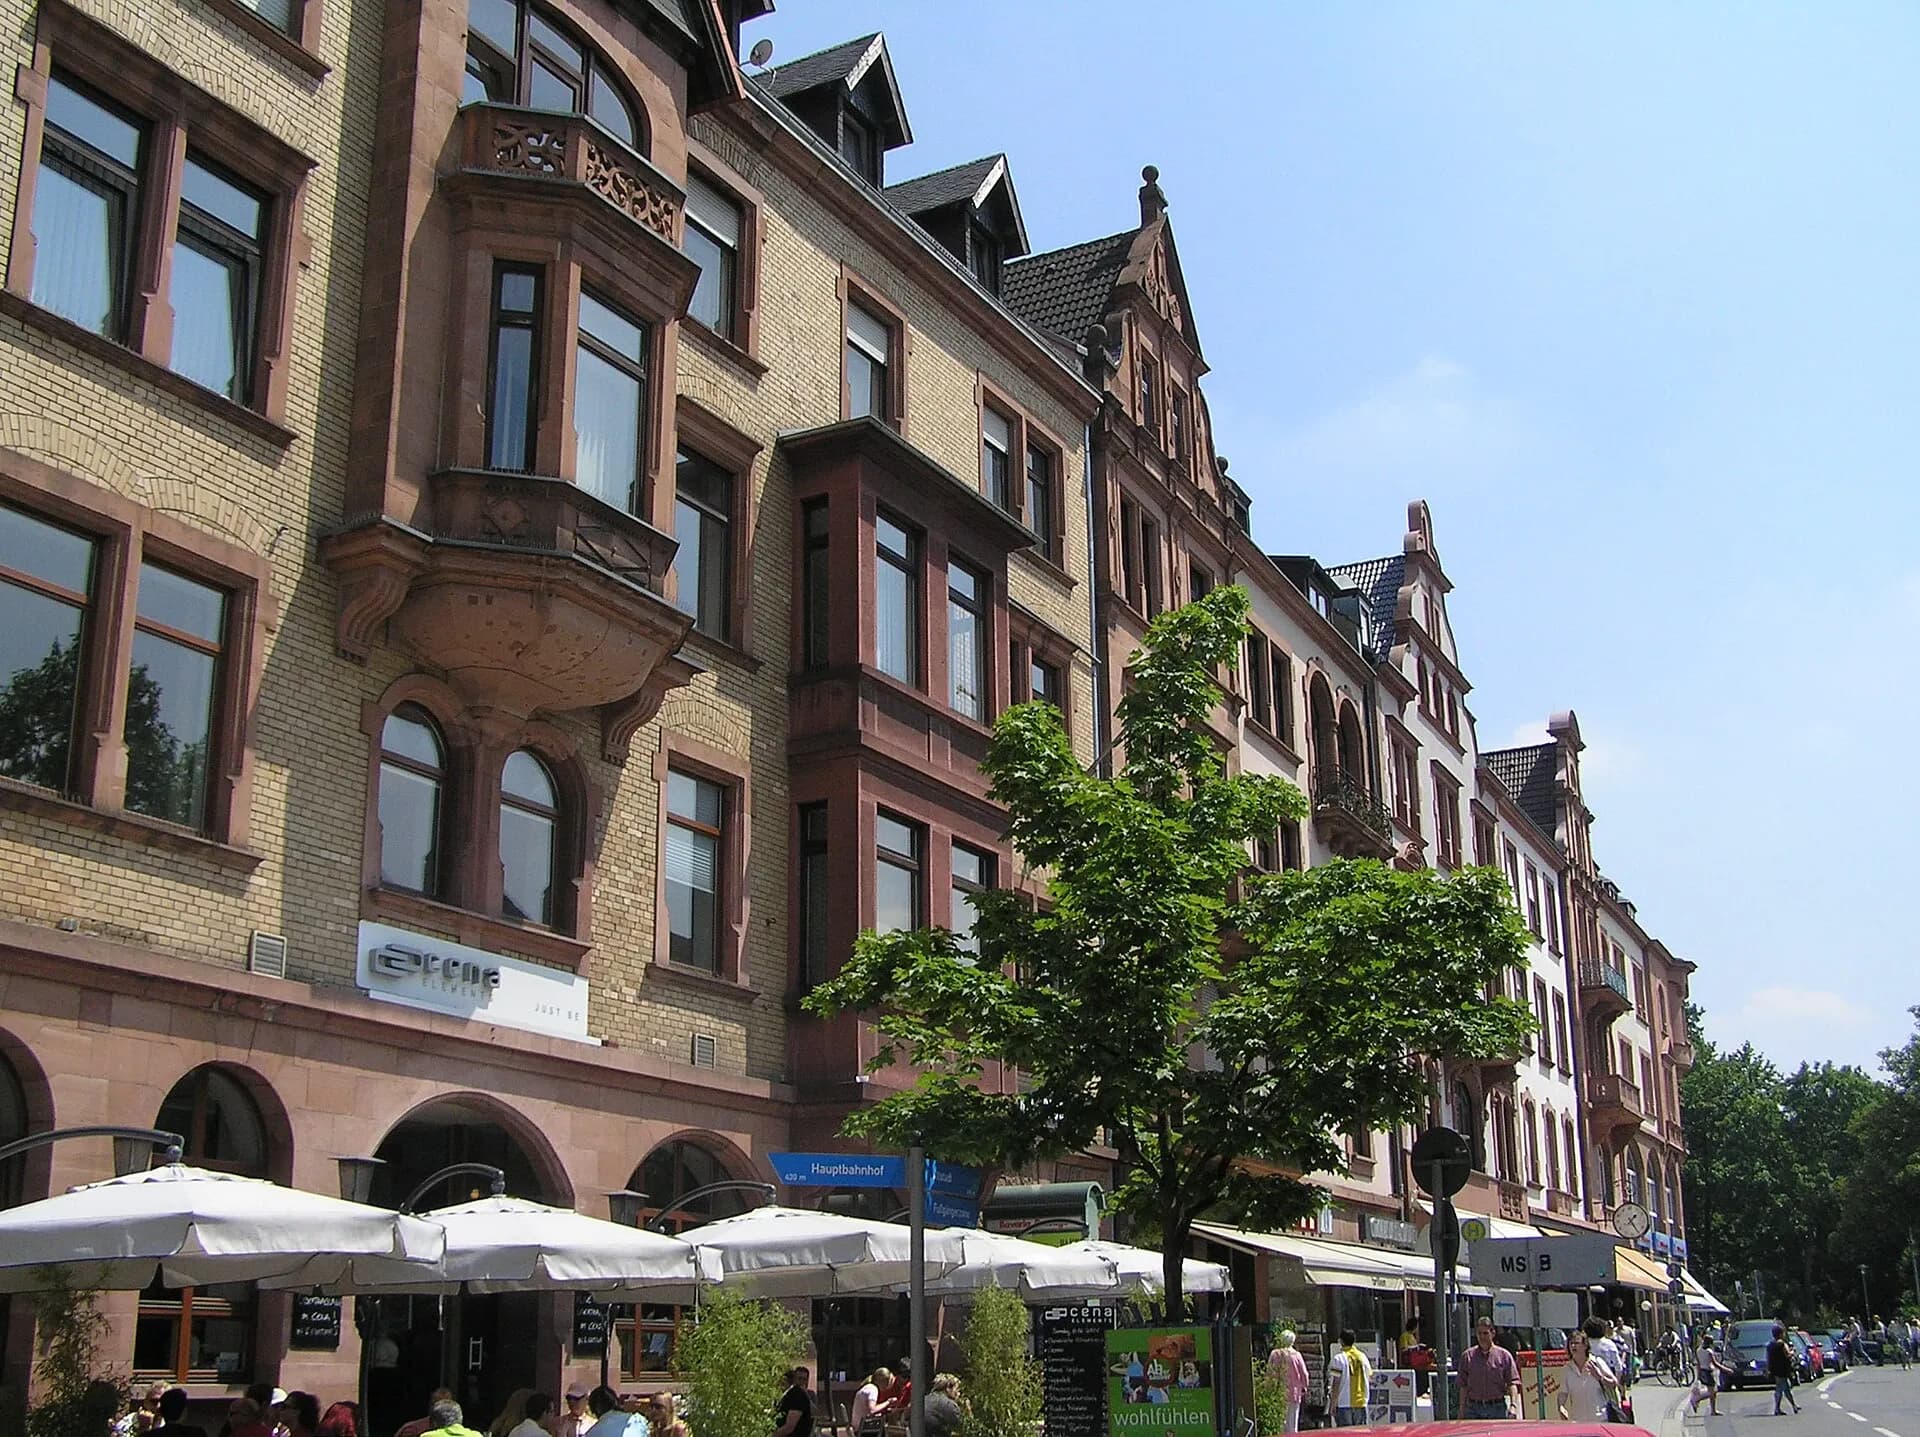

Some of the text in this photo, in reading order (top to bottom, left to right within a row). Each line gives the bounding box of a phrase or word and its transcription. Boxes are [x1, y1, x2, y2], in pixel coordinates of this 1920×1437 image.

[535, 1001, 561, 1017] JUST
[811, 1162, 885, 1177] Hauptbahnhof
[1501, 1256, 1527, 1272] MS
[1114, 1408, 1210, 1425] wohlfühlen
